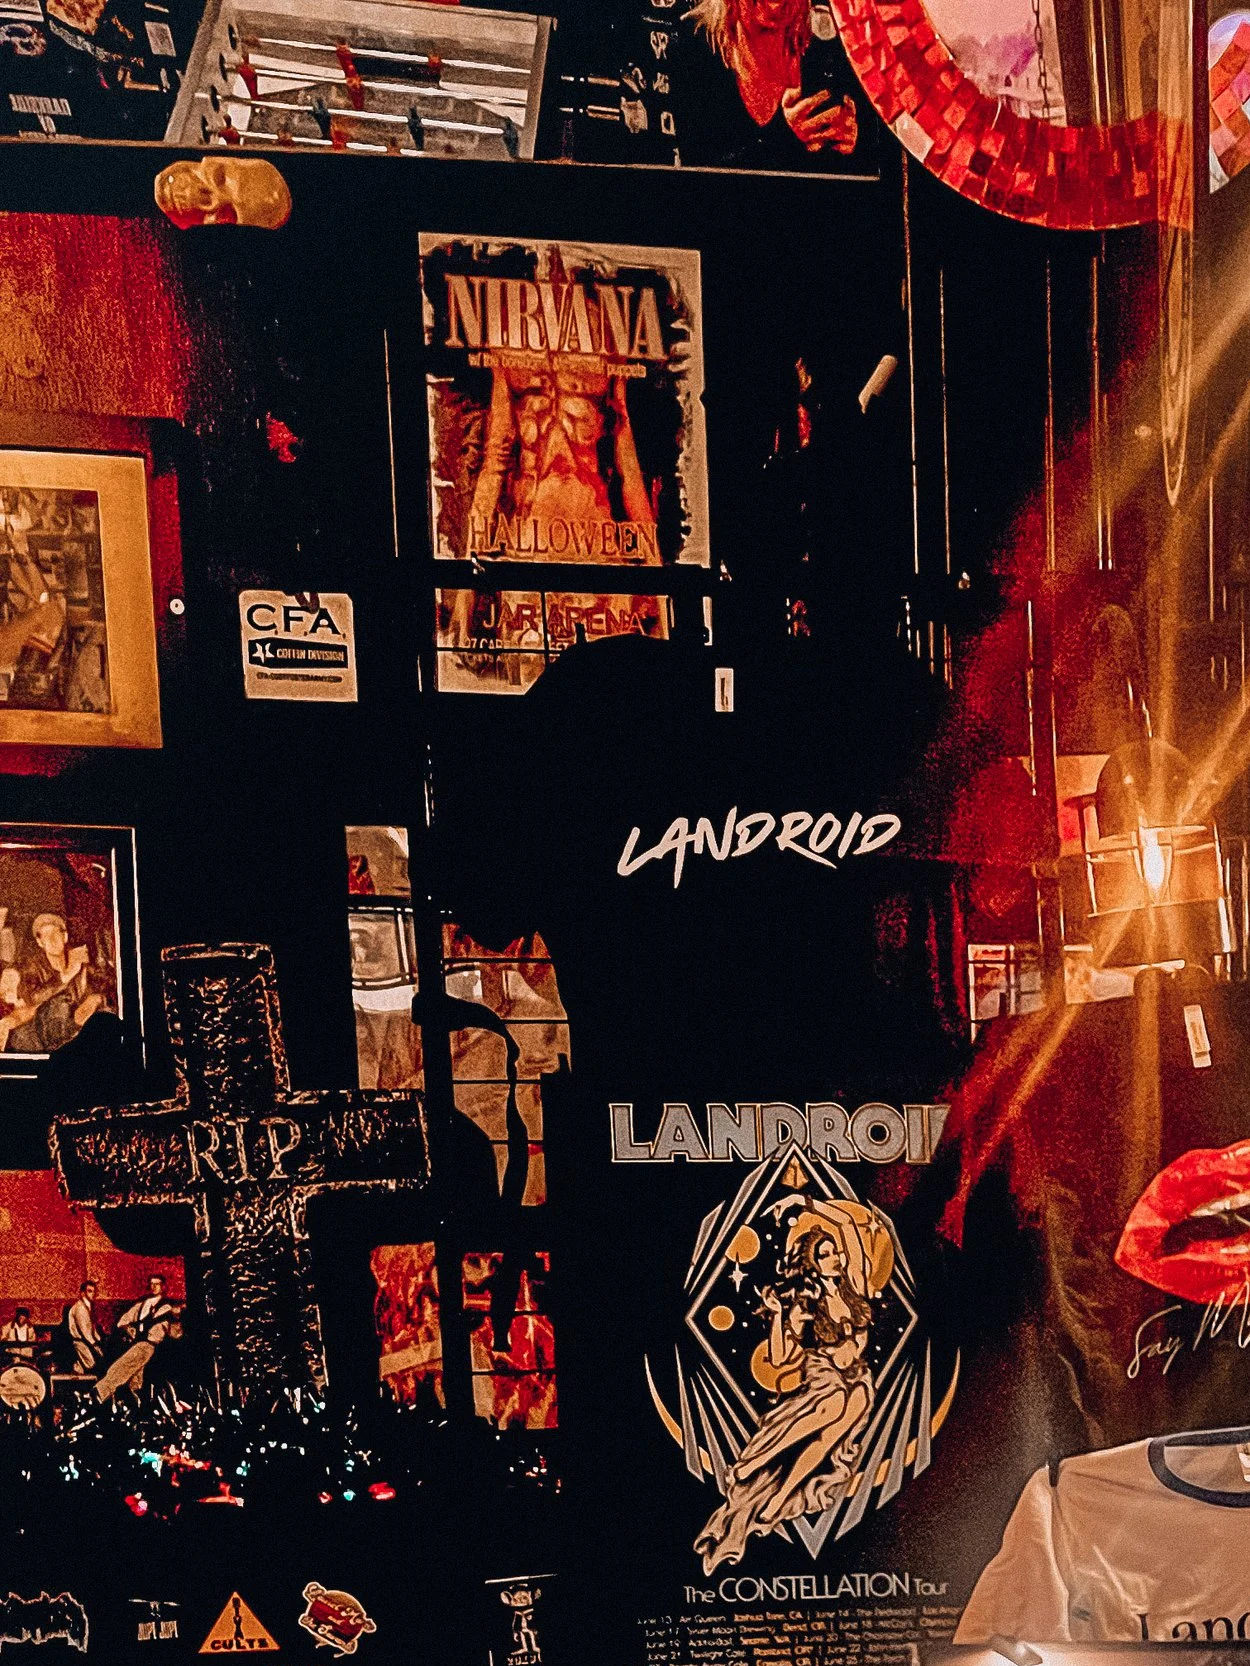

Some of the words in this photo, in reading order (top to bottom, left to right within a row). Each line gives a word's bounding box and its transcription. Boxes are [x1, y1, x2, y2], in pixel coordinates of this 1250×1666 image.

[443, 273, 668, 360] NIRVANA
[470, 516, 657, 558] HALLOWEEN
[483, 600, 539, 632] JAR
[548, 603, 645, 637] ARENA
[617, 805, 901, 889] LANDROID
[1127, 1304, 1184, 1379] Say
[683, 1585, 716, 1603] The
[718, 1572, 910, 1603] CONSTELLATION
[913, 1578, 949, 1596] Tour
[210, 1638, 271, 1651] CULTS
